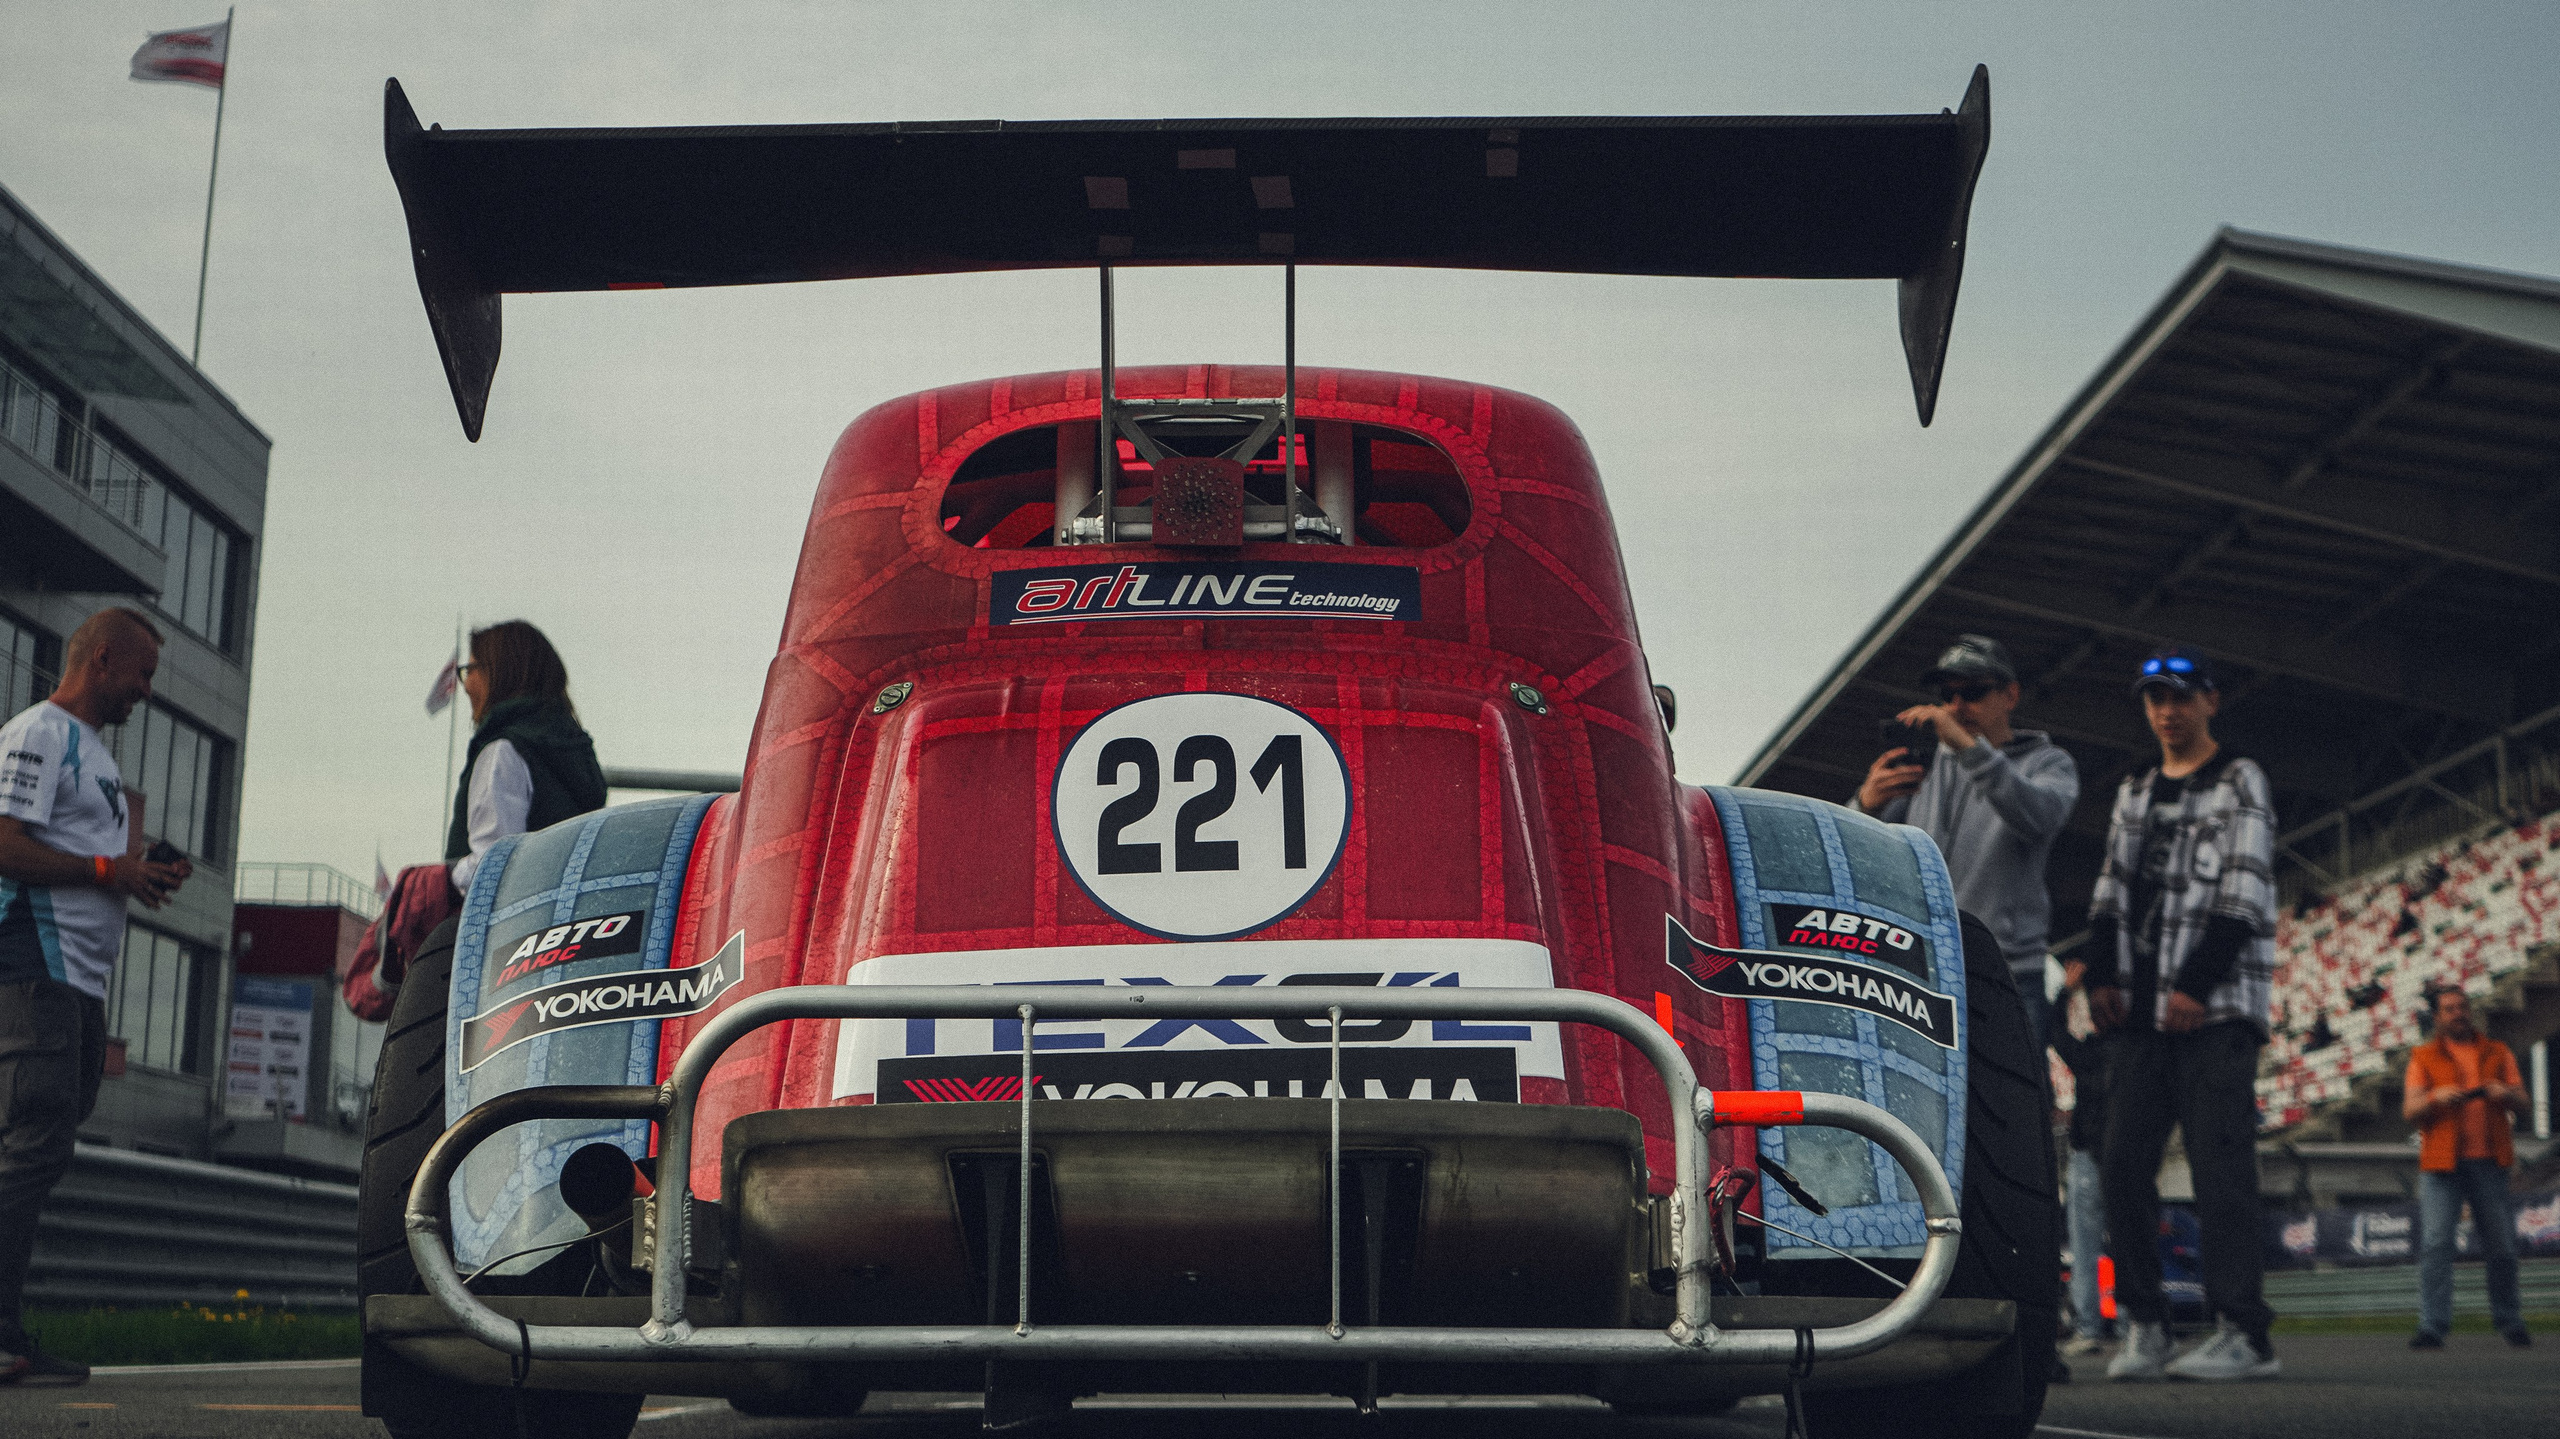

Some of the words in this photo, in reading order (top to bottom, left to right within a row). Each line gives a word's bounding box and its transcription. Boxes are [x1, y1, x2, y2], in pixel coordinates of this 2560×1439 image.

[1015, 566, 1295, 613] artLINE
[1289, 590, 1401, 613] technology
[1096, 734, 1307, 875] 221
[505, 914, 632, 967] АВТО
[1788, 929, 1879, 954] ПЛЮС
[1795, 909, 1915, 952] АВТО
[496, 944, 581, 988] ПЛЮС
[533, 962, 725, 1024] YOKOHAMA
[1737, 960, 1935, 1030] YOKOHAMA
